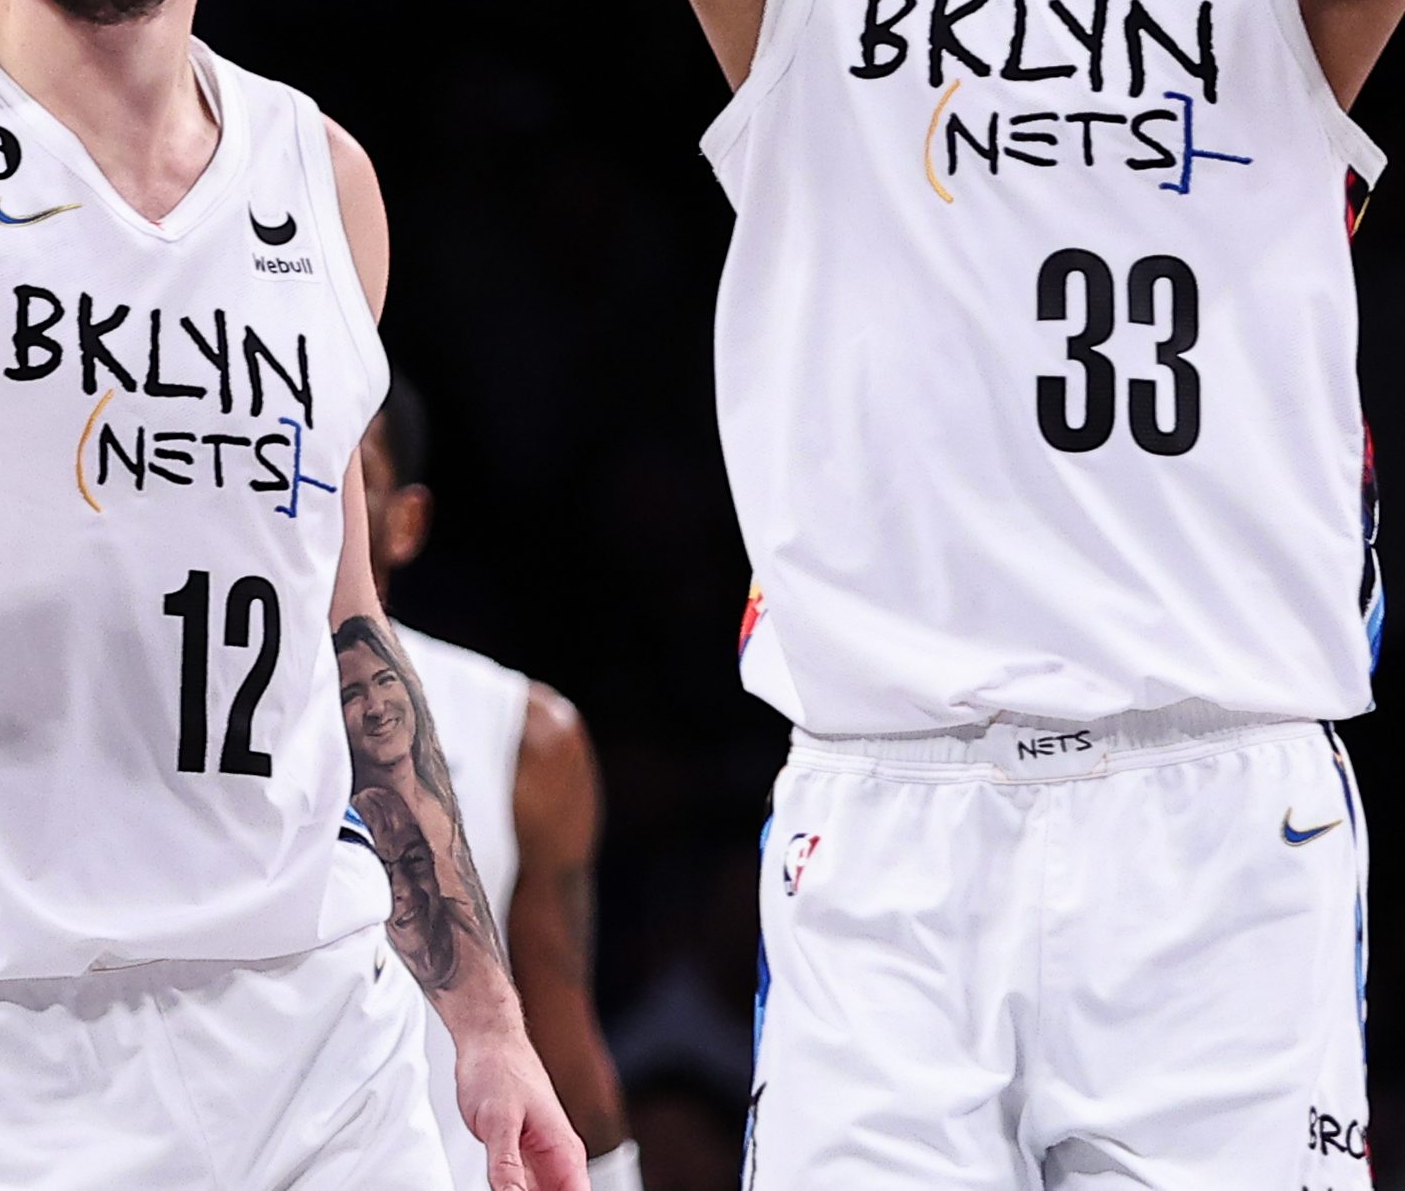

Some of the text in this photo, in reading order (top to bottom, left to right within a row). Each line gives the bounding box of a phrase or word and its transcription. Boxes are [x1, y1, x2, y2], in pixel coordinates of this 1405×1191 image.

[252, 252, 314, 275] Webull
[3, 284, 314, 430] BKLYN
[1036, 247, 1201, 457] 33
[163, 569, 282, 778] 12
[1017, 729, 1093, 761] NETS
